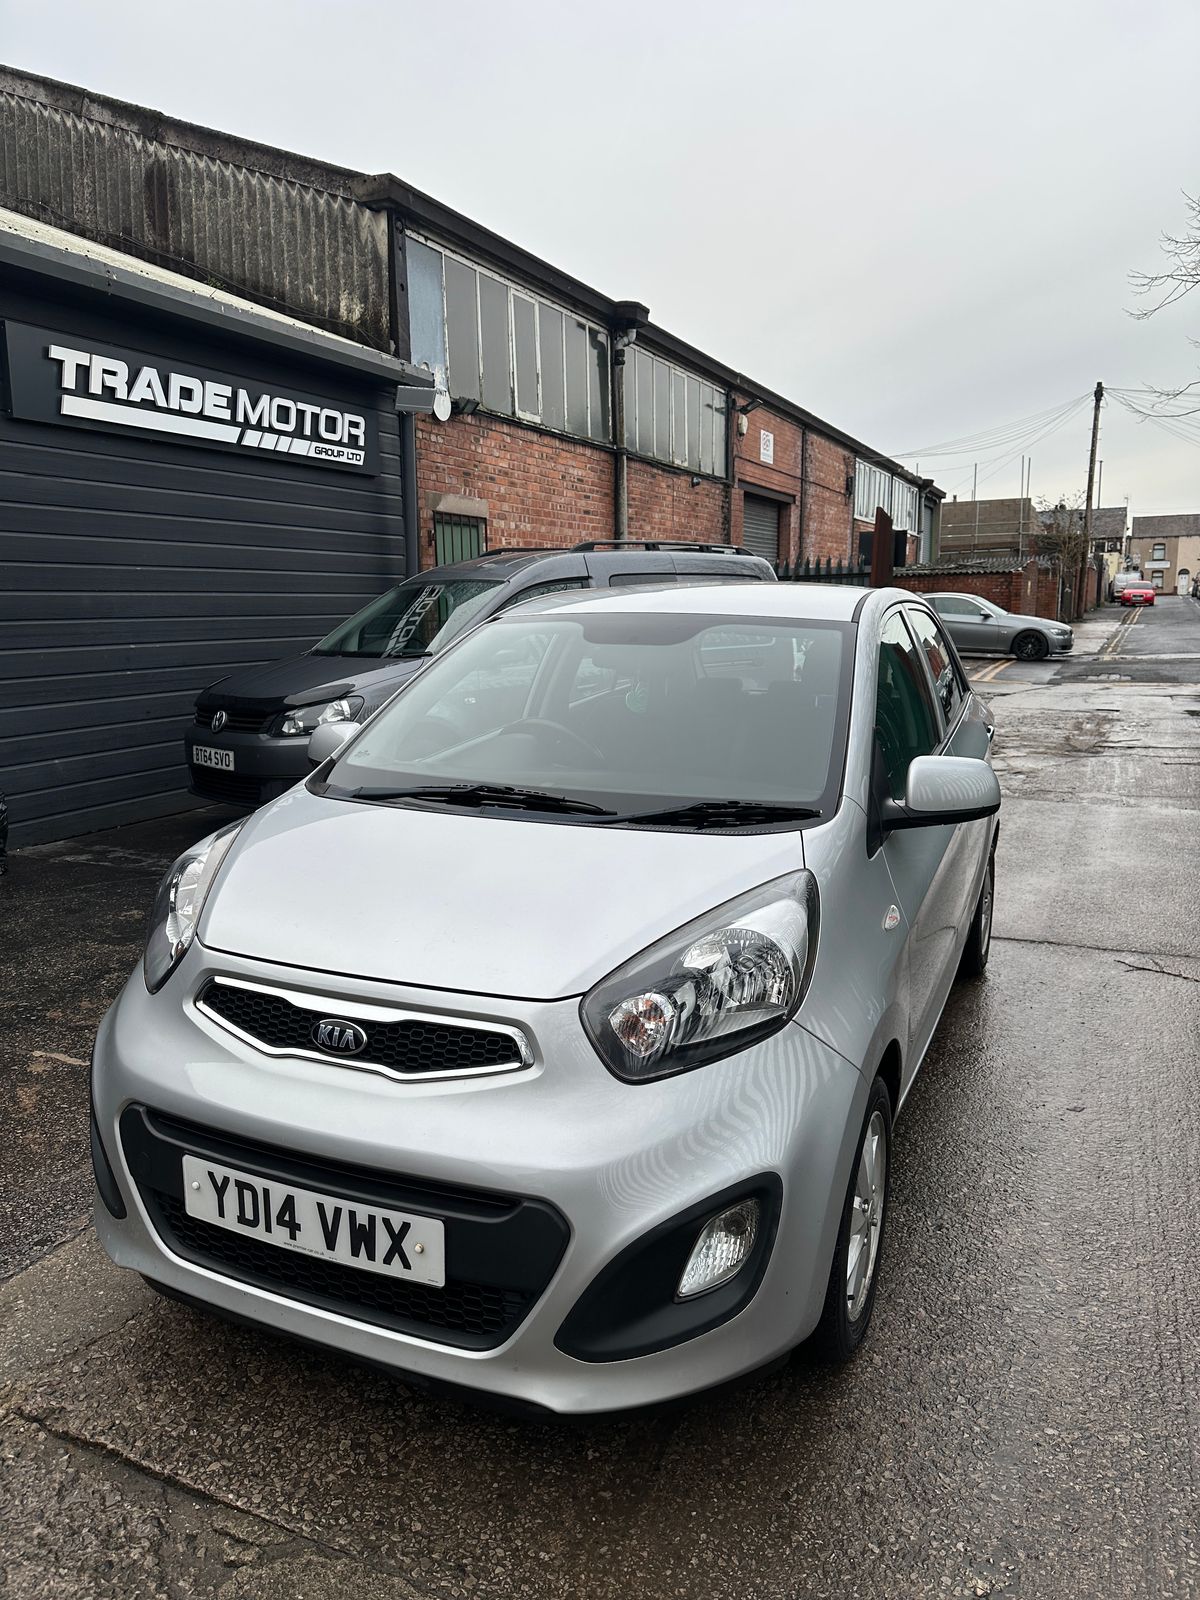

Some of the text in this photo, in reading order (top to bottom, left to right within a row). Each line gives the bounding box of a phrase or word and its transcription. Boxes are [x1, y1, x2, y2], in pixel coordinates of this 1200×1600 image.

[49, 345, 365, 446] TRADE MOTOR
[315, 446, 361, 461] GROUP LTD
[195, 748, 212, 764] BT64
[318, 1024, 355, 1049] KIA
[208, 1171, 411, 1270] YD14 VWX
